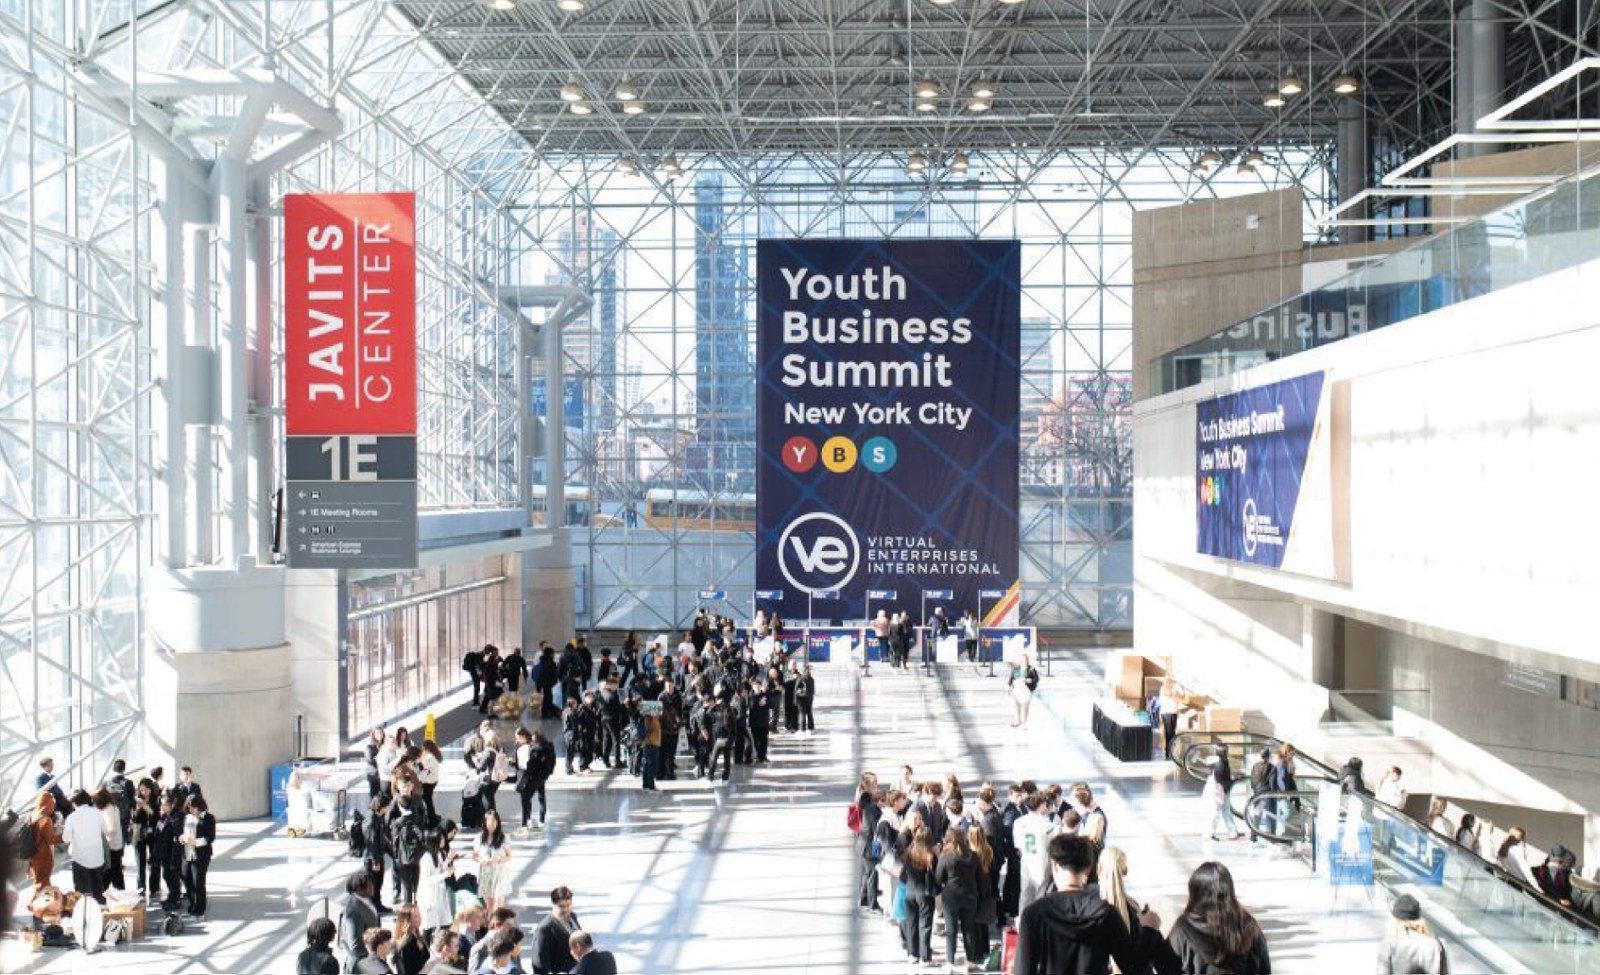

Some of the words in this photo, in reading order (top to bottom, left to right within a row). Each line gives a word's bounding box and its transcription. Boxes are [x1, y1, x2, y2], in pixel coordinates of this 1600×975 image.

[780, 266, 907, 300] Youth
[307, 223, 344, 402] JAVITS
[363, 222, 393, 402] CENTER
[782, 308, 972, 344] Business
[781, 352, 953, 388] Summit
[784, 402, 846, 424] New
[852, 402, 912, 424] York
[918, 402, 973, 430] City
[1218, 413, 1250, 440] Business
[1251, 404, 1285, 434] Summit
[321, 436, 378, 482] 1E
[792, 447, 807, 463] Y
[833, 448, 846, 463] B
[872, 447, 886, 463] S
[1231, 443, 1247, 474] City
[321, 508, 350, 518] Meeting
[352, 508, 378, 517] Rooms
[867, 536, 936, 549] VIRTUAL
[867, 550, 979, 562] ENTERPRISES
[867, 563, 1001, 575] INTERNATIONAL
[1025, 833, 1037, 854] 2
